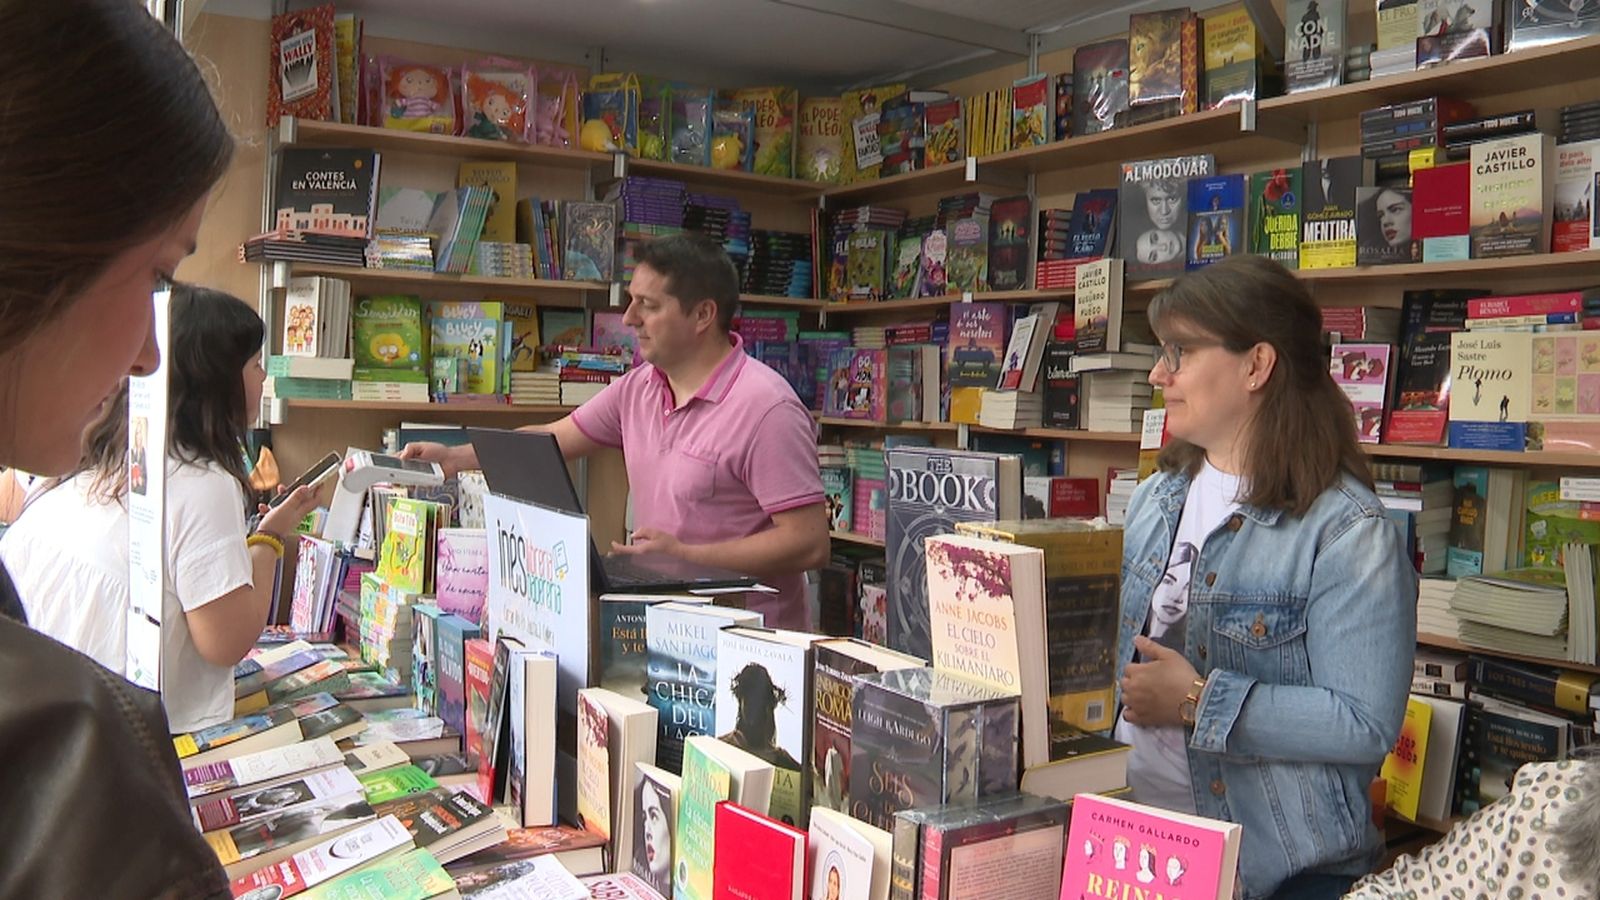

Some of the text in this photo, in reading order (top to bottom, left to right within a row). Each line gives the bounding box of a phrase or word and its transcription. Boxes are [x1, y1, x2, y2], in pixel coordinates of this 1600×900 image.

[1295, 17, 1328, 37] CON
[1288, 31, 1336, 53] NADIE
[813, 107, 840, 121] PODE
[1484, 146, 1527, 162] JAVIER
[1124, 154, 1209, 182] ALMODÓVAR
[1476, 158, 1536, 175] CASTILLO
[305, 171, 343, 181] CONTES
[291, 181, 306, 190] EN
[1264, 214, 1298, 234] QUERIDA
[1304, 219, 1357, 242] MENTIRA
[1270, 231, 1298, 250] DEBBIE
[1083, 268, 1102, 280] JAVIER
[1078, 277, 1106, 290] CASTILLO
[1457, 339, 1502, 350] José Luis
[1457, 352, 1487, 361] Sastre
[1457, 365, 1513, 381] Plomo
[929, 458, 951, 473] THE
[900, 468, 982, 511] BOOK
[615, 614, 646, 623] ANTONI
[934, 601, 1008, 631] ANNE JACOBS
[612, 626, 637, 640] Está
[667, 622, 706, 640] MIKEL
[947, 623, 996, 649] EL CIELO
[633, 643, 644, 653] te
[954, 644, 981, 658] SOBRE
[677, 663, 698, 683] LA
[936, 650, 1014, 687] KILIMANJARO
[816, 689, 853, 722] ROMA
[672, 704, 708, 731] DEL
[858, 708, 883, 729] LEIGH
[1091, 812, 1200, 847] CARMEN GALLARDO
[1087, 872, 1182, 900] REIN
